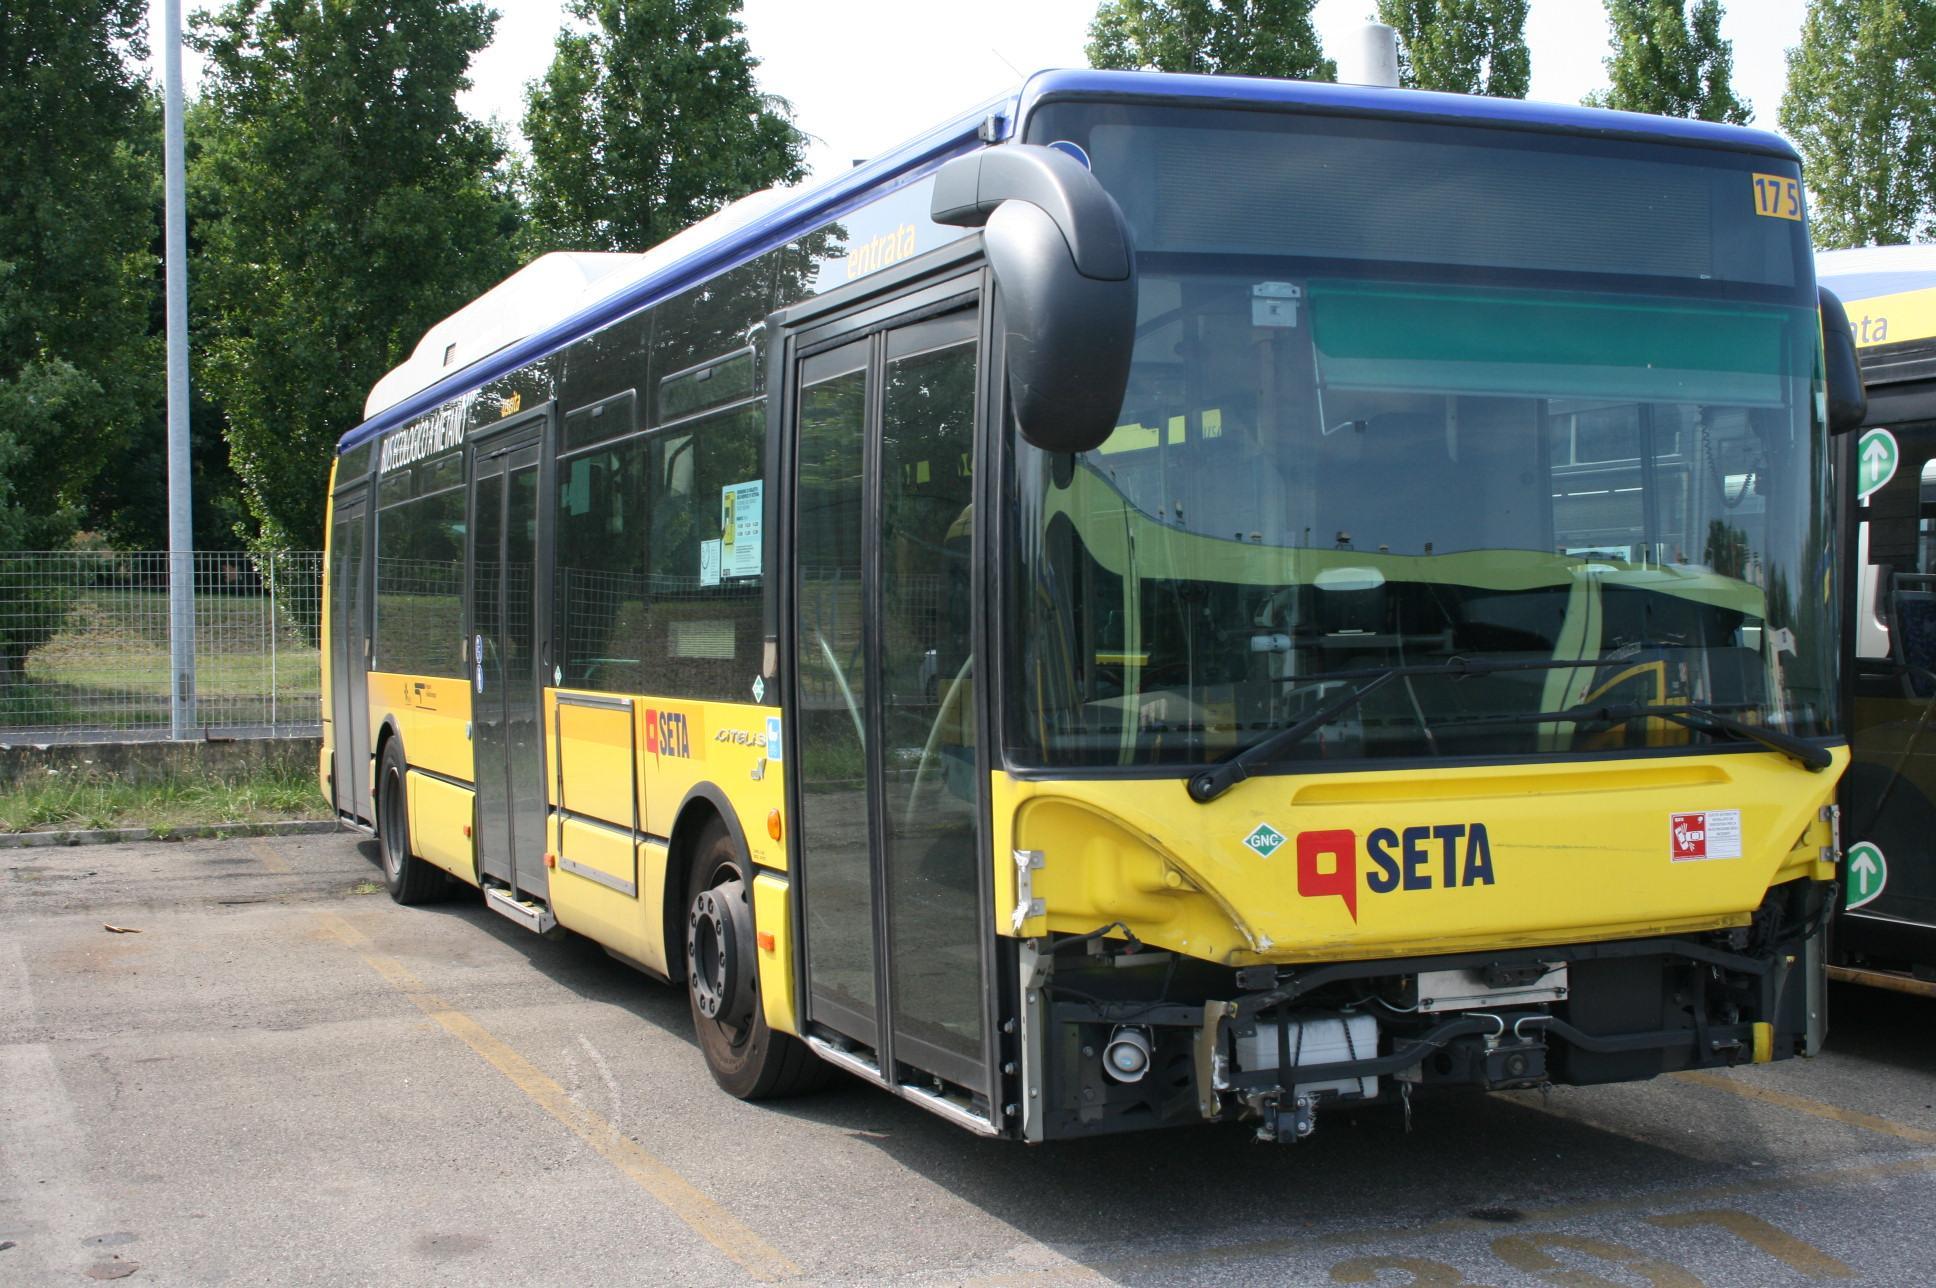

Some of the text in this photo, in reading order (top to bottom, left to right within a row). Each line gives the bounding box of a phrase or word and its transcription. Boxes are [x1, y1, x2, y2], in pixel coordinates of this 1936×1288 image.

[1755, 178, 1799, 217] 175
[847, 223, 916, 280] entrata
[500, 390, 521, 418] uscita
[380, 436, 396, 474] BUS
[391, 419, 430, 470] ECOLOGICO
[433, 404, 468, 455] METANO
[658, 711, 690, 759] SETA
[1250, 834, 1279, 848] GNC
[1366, 822, 1495, 894] SETA
